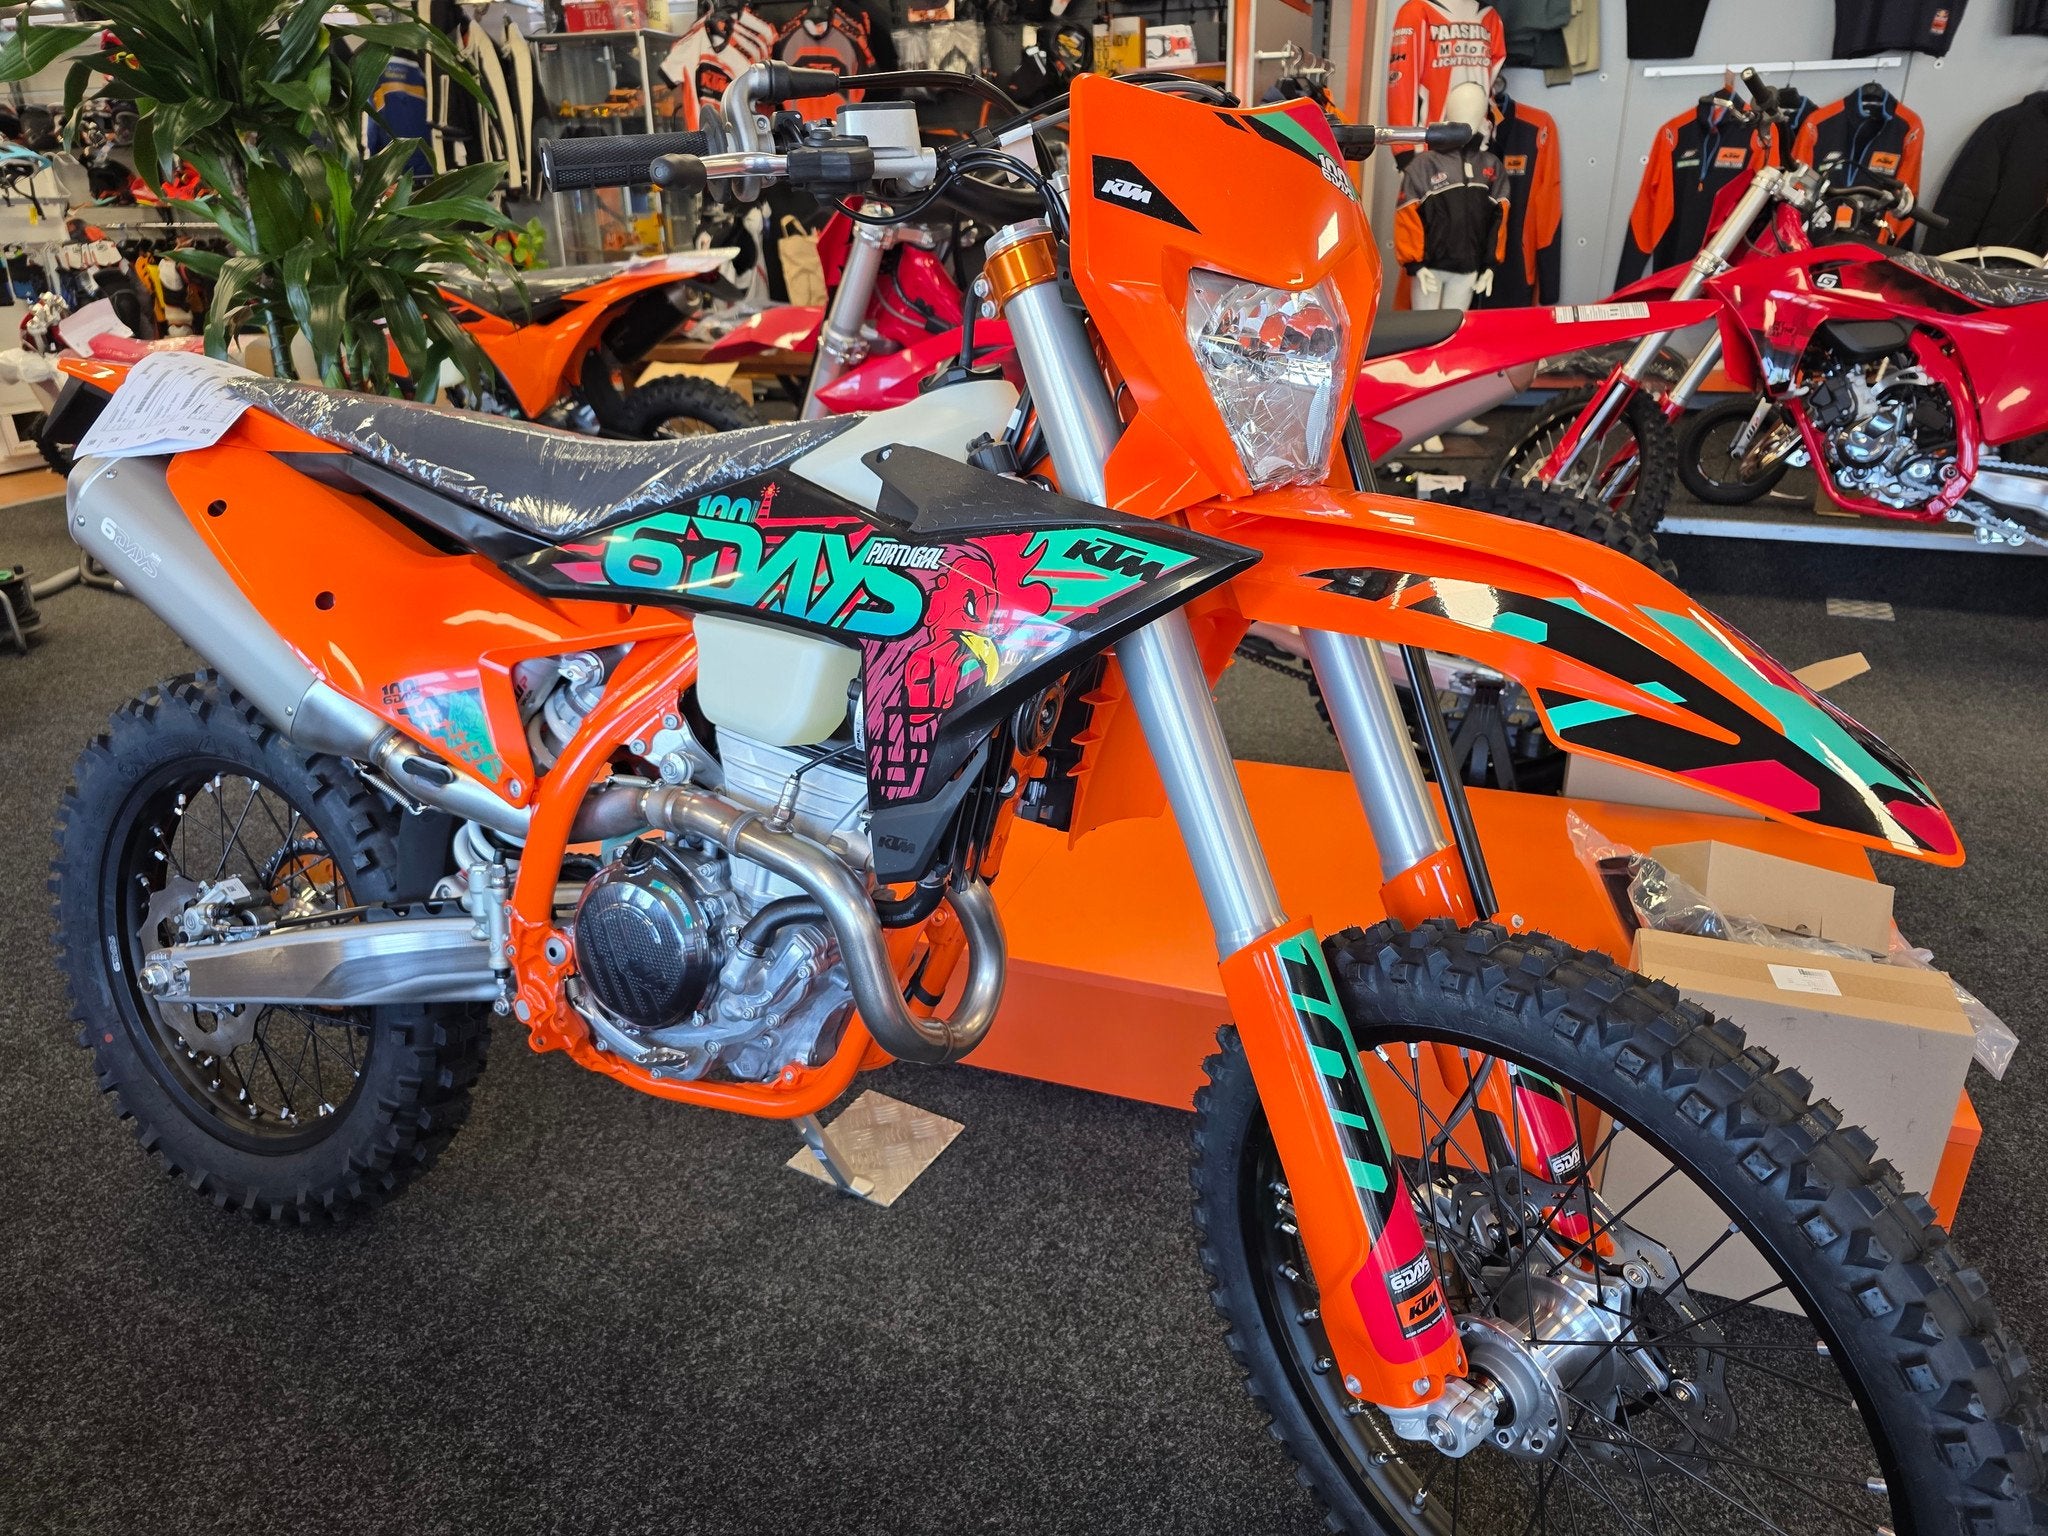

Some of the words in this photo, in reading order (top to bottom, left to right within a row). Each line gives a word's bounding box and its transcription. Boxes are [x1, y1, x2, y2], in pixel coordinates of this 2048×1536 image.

[1100, 178, 1152, 204] KTM
[697, 494, 752, 522] 100
[100, 516, 160, 579] 6DAYS
[865, 541, 944, 571] PORTUGAL
[1062, 537, 1166, 582] KTM
[601, 511, 925, 637] 6DAYS
[878, 834, 917, 854] KTM
[1390, 1254, 1431, 1292] 6DAYS
[1408, 1289, 1439, 1321] KTM
